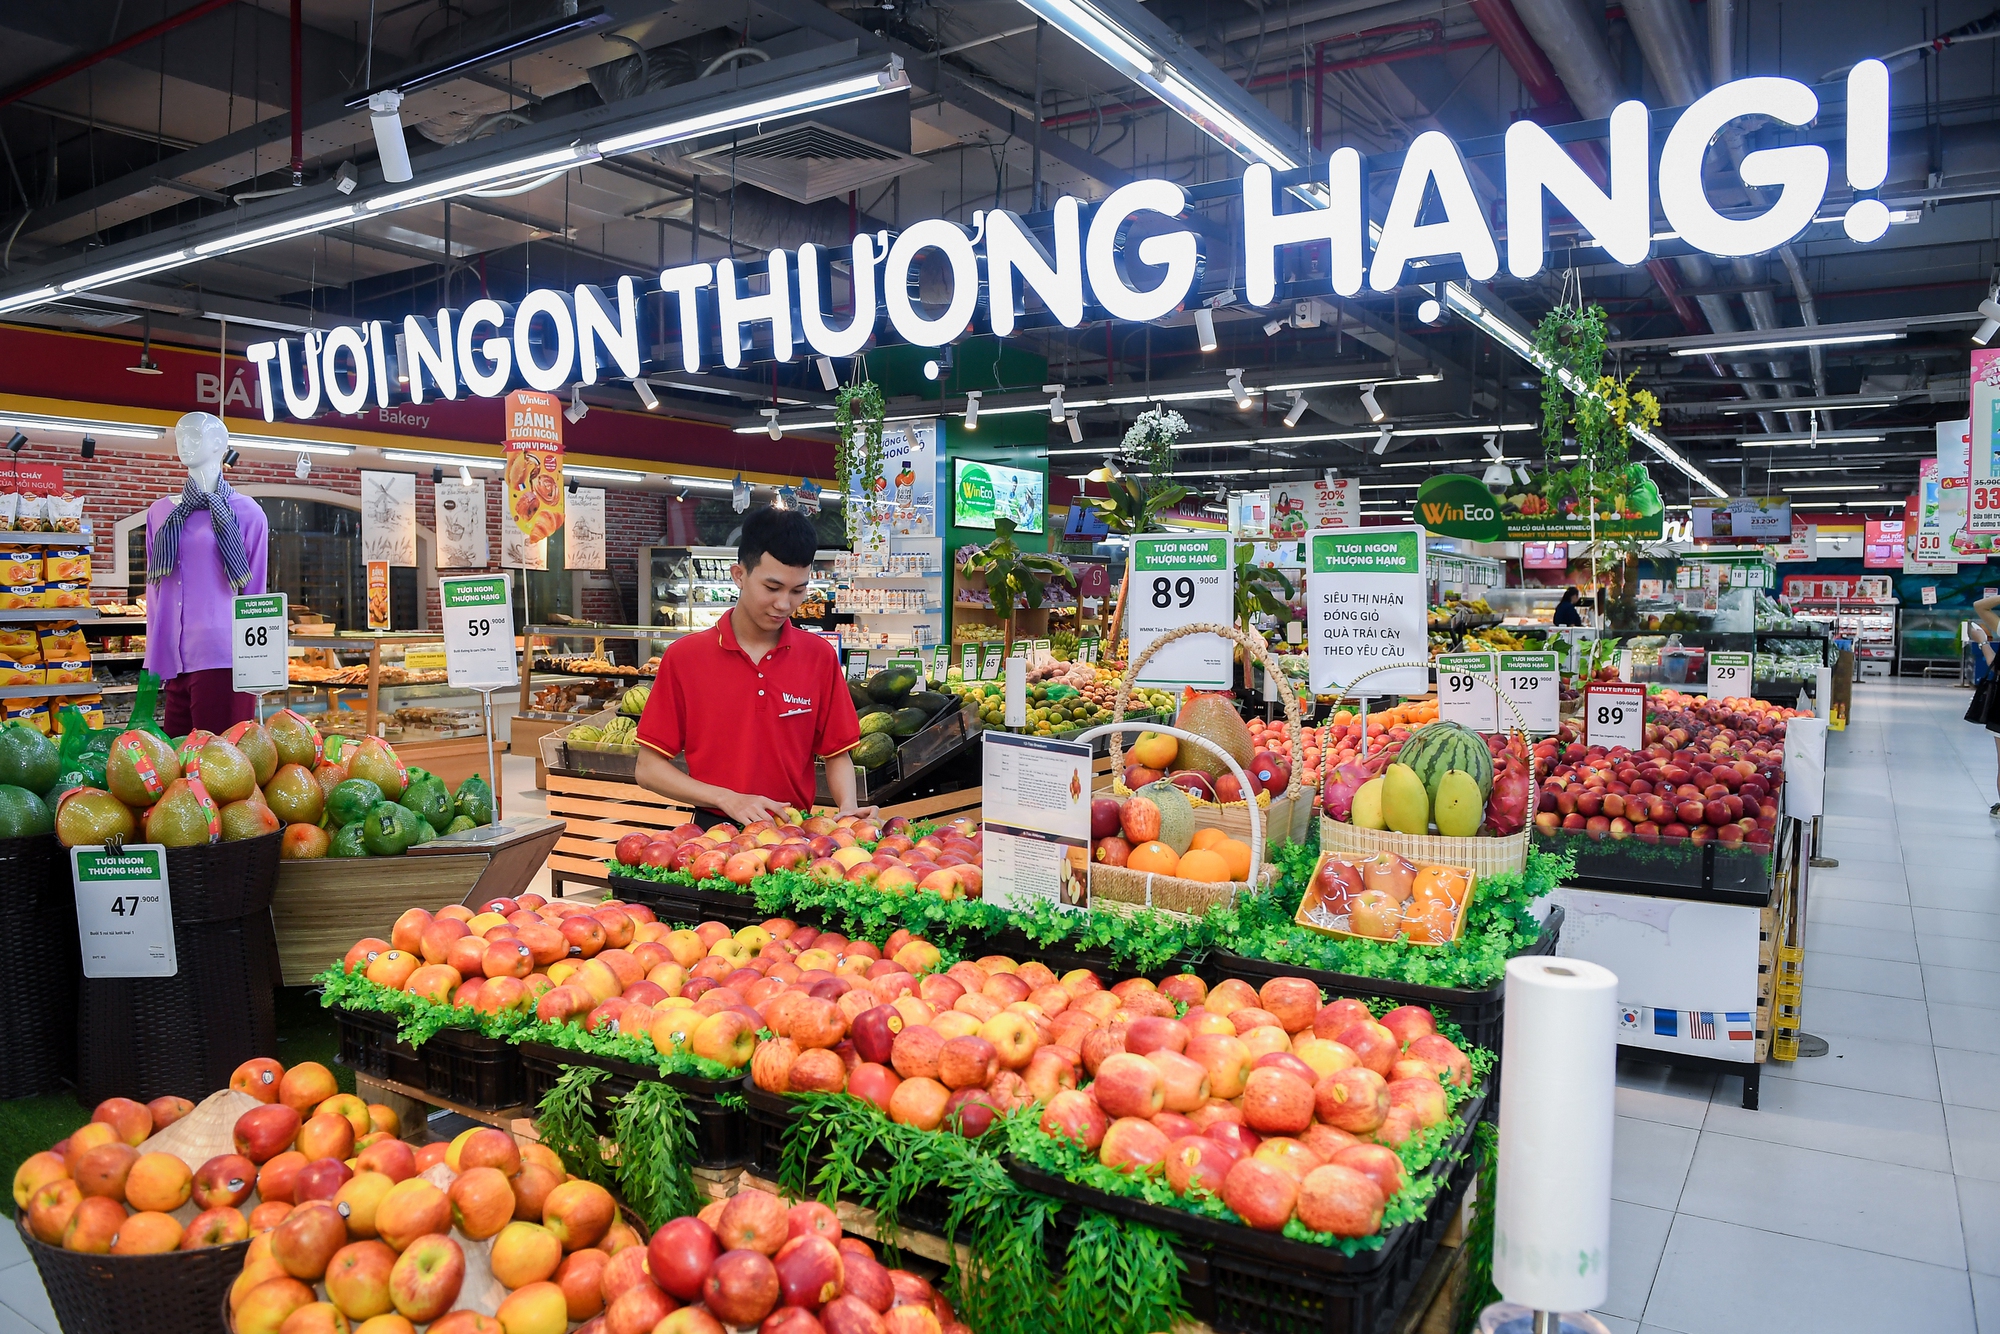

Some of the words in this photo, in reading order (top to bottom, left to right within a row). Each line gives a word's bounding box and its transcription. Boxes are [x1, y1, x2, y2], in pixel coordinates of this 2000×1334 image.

[246, 319, 389, 423] TƯƠI
[403, 275, 641, 406] NGON
[660, 178, 1196, 381] THƯỢNG
[1243, 58, 1892, 326] HẠNG!
[518, 393, 549, 406] WinMart
[379, 408, 430, 429] Bakery
[514, 407, 555, 430] BÁNH
[511, 428, 532, 438] TƯƠI
[534, 430, 559, 440] NGON
[512, 442, 532, 451] TRỌN
[532, 443, 540, 451] VỊ
[540, 442, 558, 452] PHÁP
[21, 471, 42, 479] CHÁY
[32, 481, 56, 489] NGƯỜI
[962, 481, 993, 499] WinEco
[1320, 490, 1345, 500] 20%
[1179, 503, 1195, 517] KHU
[1421, 502, 1494, 524] WinEco
[1154, 544, 1177, 553] TƯƠI
[1179, 543, 1208, 552] NGON
[1335, 544, 1362, 553] TƯƠI
[1365, 543, 1397, 552] NGON
[1145, 555, 1187, 566] THƯỢNG
[1189, 554, 1217, 565] HẠNG
[1325, 555, 1373, 567] THƯỢNG
[1376, 555, 1406, 567] HẠNG
[456, 586, 473, 594] TƯƠI
[1152, 577, 1195, 608] 89
[1197, 576, 1219, 584] .900đ
[451, 595, 480, 603] THƯỢNG
[480, 593, 500, 601] HẠNG
[1323, 591, 1348, 604] SIÊU
[1352, 593, 1369, 606] THỊ
[1371, 592, 1404, 607] NHẬN
[1323, 608, 1357, 621] ĐÓNG
[1360, 608, 1379, 622] GIỎ
[468, 619, 490, 636] 59
[1323, 625, 1349, 639] QUÀ
[1353, 626, 1377, 639] TRÁI
[1380, 627, 1400, 639] CÂY
[245, 626, 268, 647] 68
[1323, 646, 1353, 656] THEO
[1357, 643, 1378, 656] YÊU
[1381, 642, 1405, 656] CẦU
[936, 661, 944, 670] 39
[965, 660, 973, 668] 35
[986, 658, 995, 667] 65
[1717, 667, 1735, 679] 29
[1450, 675, 1474, 692] 99
[1510, 676, 1539, 690] 129
[1624, 687, 1640, 695] MẠI
[782, 691, 811, 706] WinMart
[1597, 707, 1623, 724] 89
[95, 857, 116, 865] TƯƠI
[118, 856, 144, 864] NGON
[88, 867, 127, 876] THƯỢNG
[128, 866, 153, 875] HẠNG
[111, 896, 139, 916] 47
